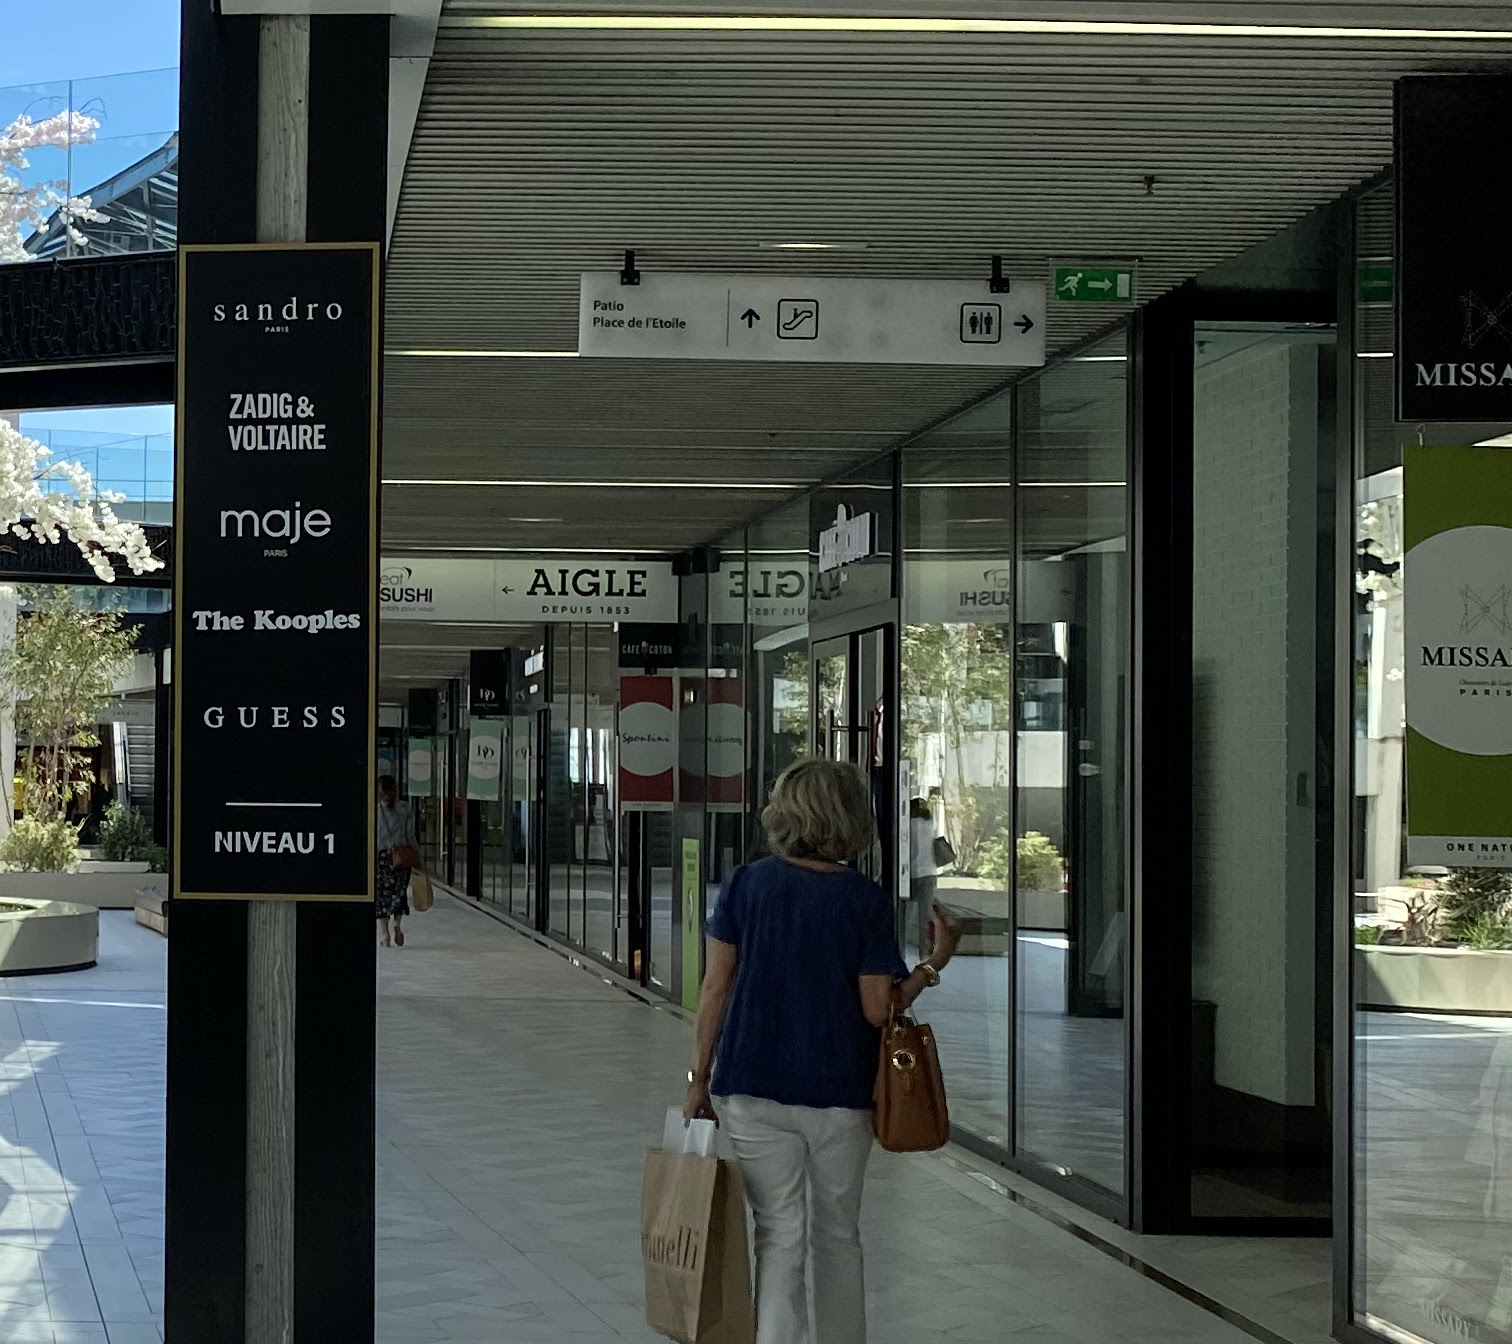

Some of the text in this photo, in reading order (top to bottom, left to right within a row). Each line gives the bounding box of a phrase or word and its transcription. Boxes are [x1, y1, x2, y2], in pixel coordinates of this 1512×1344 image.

[214, 297, 342, 321] sandro
[593, 300, 624, 311] Patio
[593, 317, 686, 329] Place de l'Etoile
[229, 393, 293, 418] ZADIG
[228, 424, 326, 450] VOLTAIRE
[220, 501, 331, 544] maje
[380, 573, 405, 586] eat
[526, 568, 647, 597] AIGLE
[380, 588, 433, 603] SUSHI
[192, 609, 360, 633] The Kooples
[542, 605, 630, 615] DEPUIS 1853
[1459, 689, 1512, 697] PARIS
[204, 706, 345, 728] GUESS
[214, 831, 335, 854] NIVEAU 1
[1446, 843, 1474, 852] ONE
